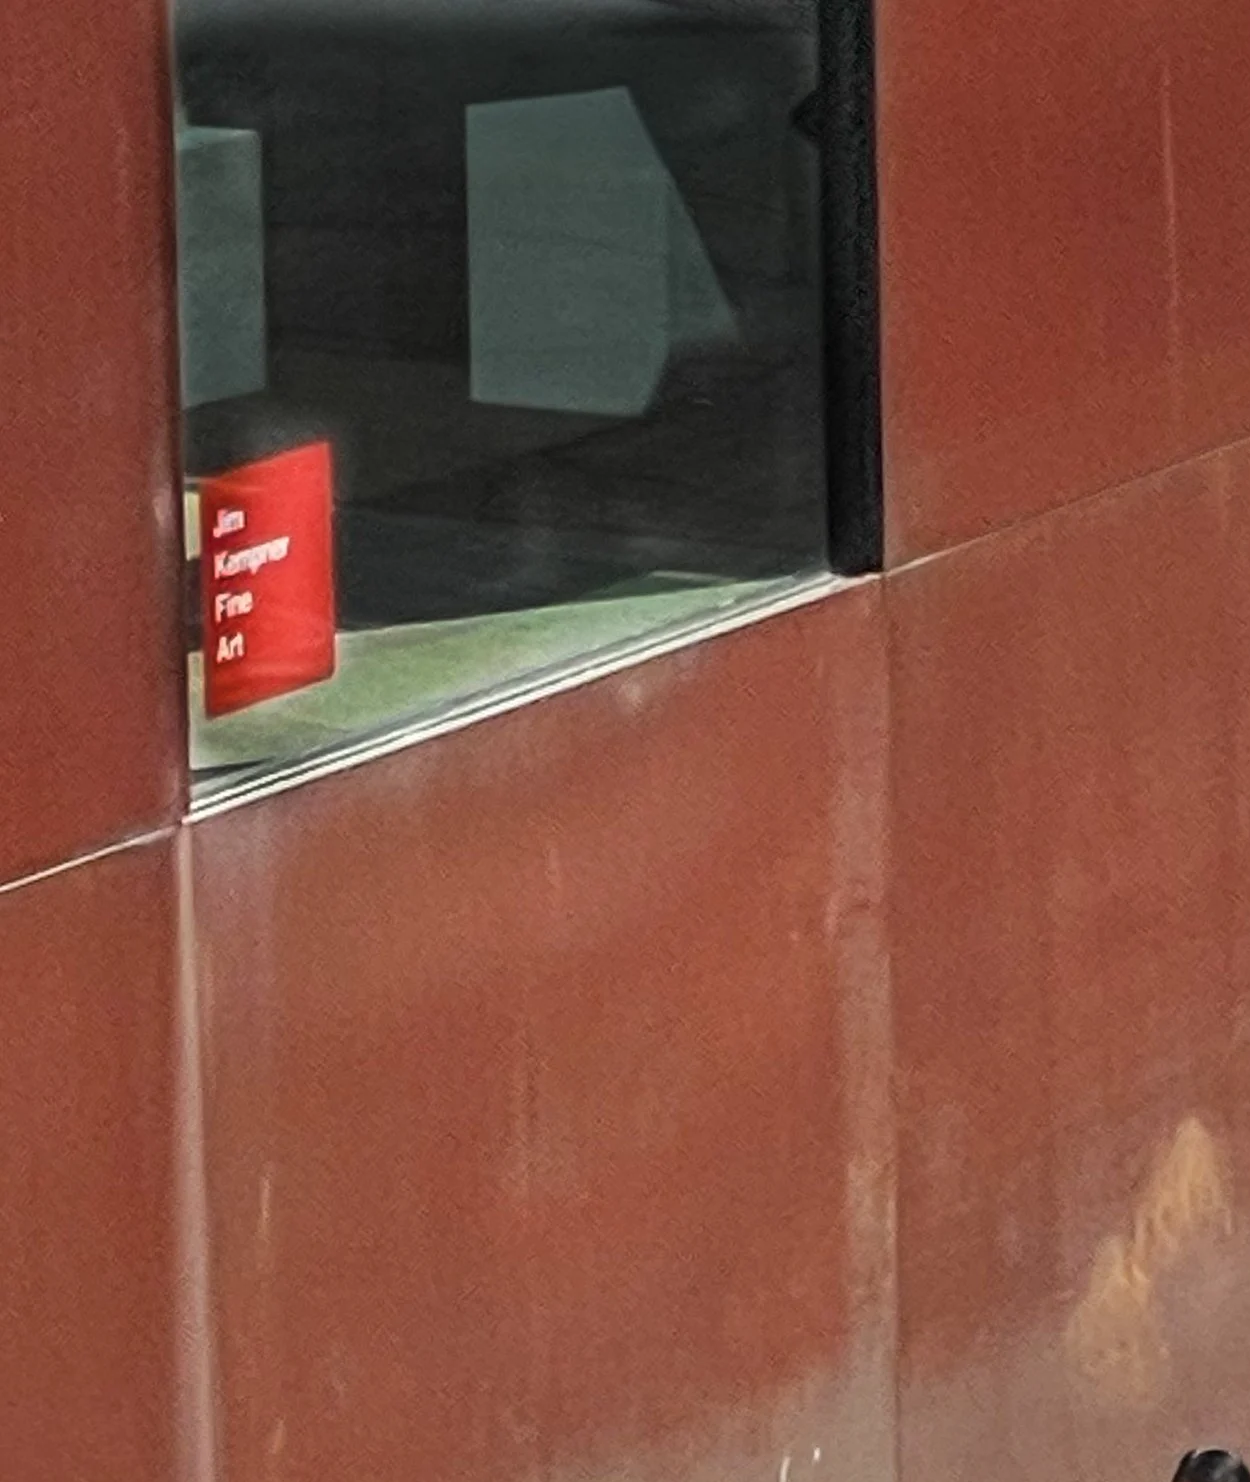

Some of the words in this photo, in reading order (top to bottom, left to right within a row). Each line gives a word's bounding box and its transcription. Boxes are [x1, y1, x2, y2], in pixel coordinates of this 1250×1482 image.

[213, 508, 246, 538] Jim
[214, 590, 254, 623] Fine
[216, 632, 245, 663] Art
